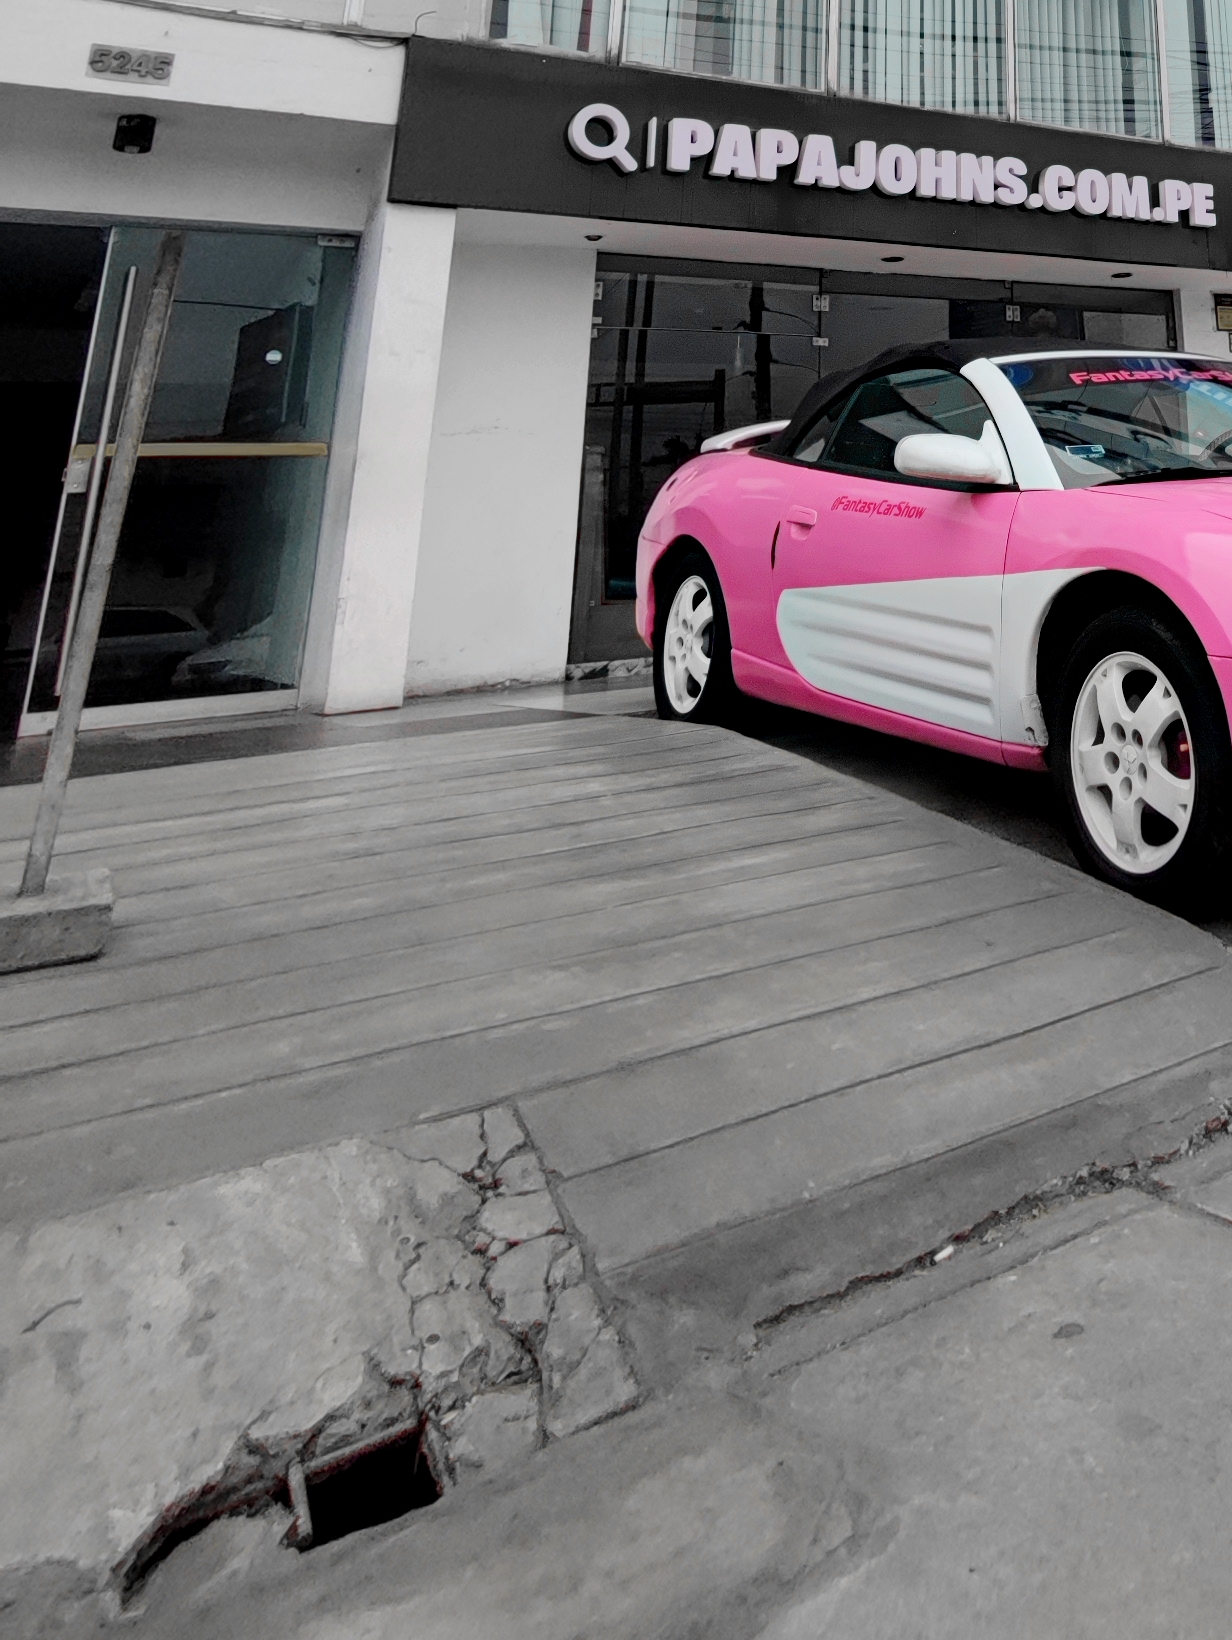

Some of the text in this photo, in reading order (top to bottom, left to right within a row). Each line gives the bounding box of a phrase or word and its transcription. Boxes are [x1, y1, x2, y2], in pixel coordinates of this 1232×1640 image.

[89, 48, 172, 81] 5245
[666, 117, 1217, 229] PAPAJOHNS.COM.PE
[831, 496, 927, 519] @FantasyCarShow
